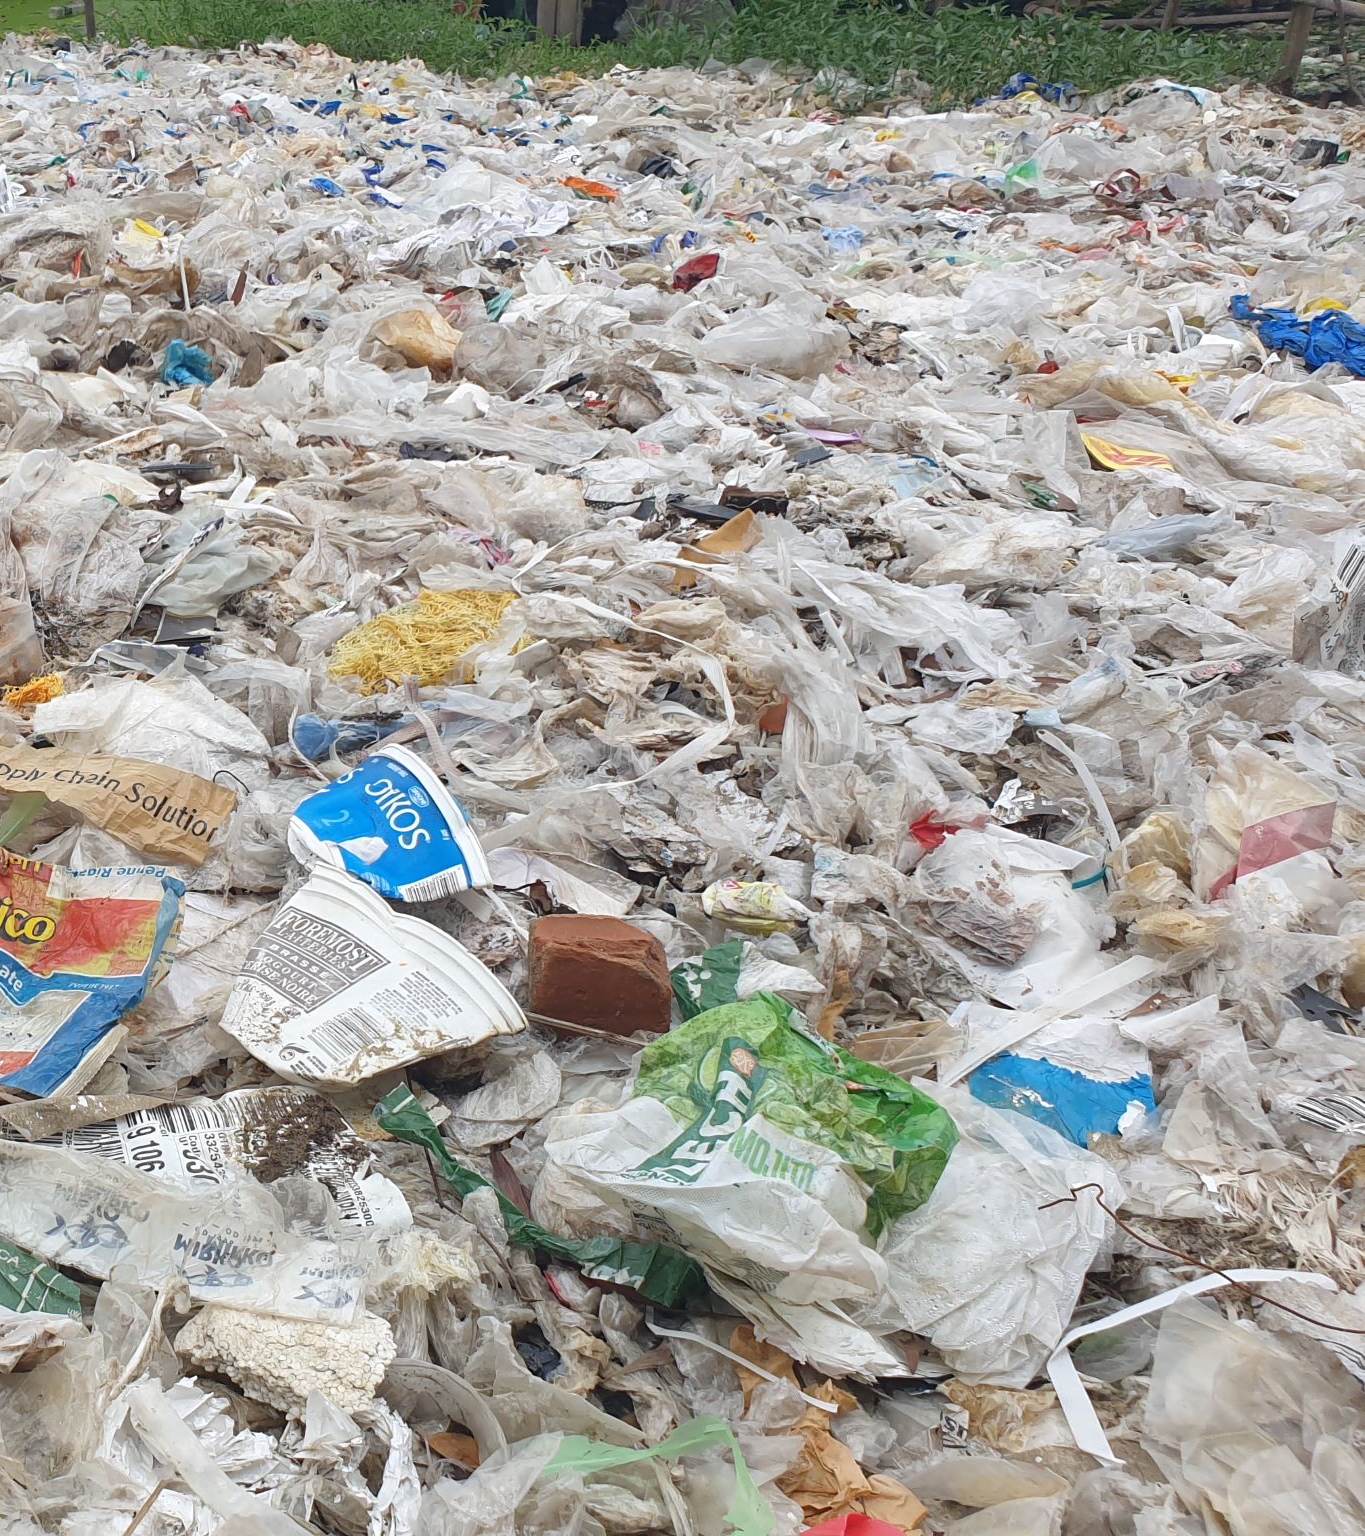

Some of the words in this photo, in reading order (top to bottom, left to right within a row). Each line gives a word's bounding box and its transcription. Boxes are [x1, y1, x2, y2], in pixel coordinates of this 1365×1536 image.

[53, 768, 122, 791] Chain
[273, 911, 380, 973] FOREMOST
[277, 926, 350, 970] LAITERIES
[256, 951, 318, 990] YOGOURT
[269, 943, 333, 980] BRASSÉ
[276, 974, 320, 1006] NOIRE
[649, 1069, 754, 1178] LECH
[130, 1140, 166, 1173] 106
